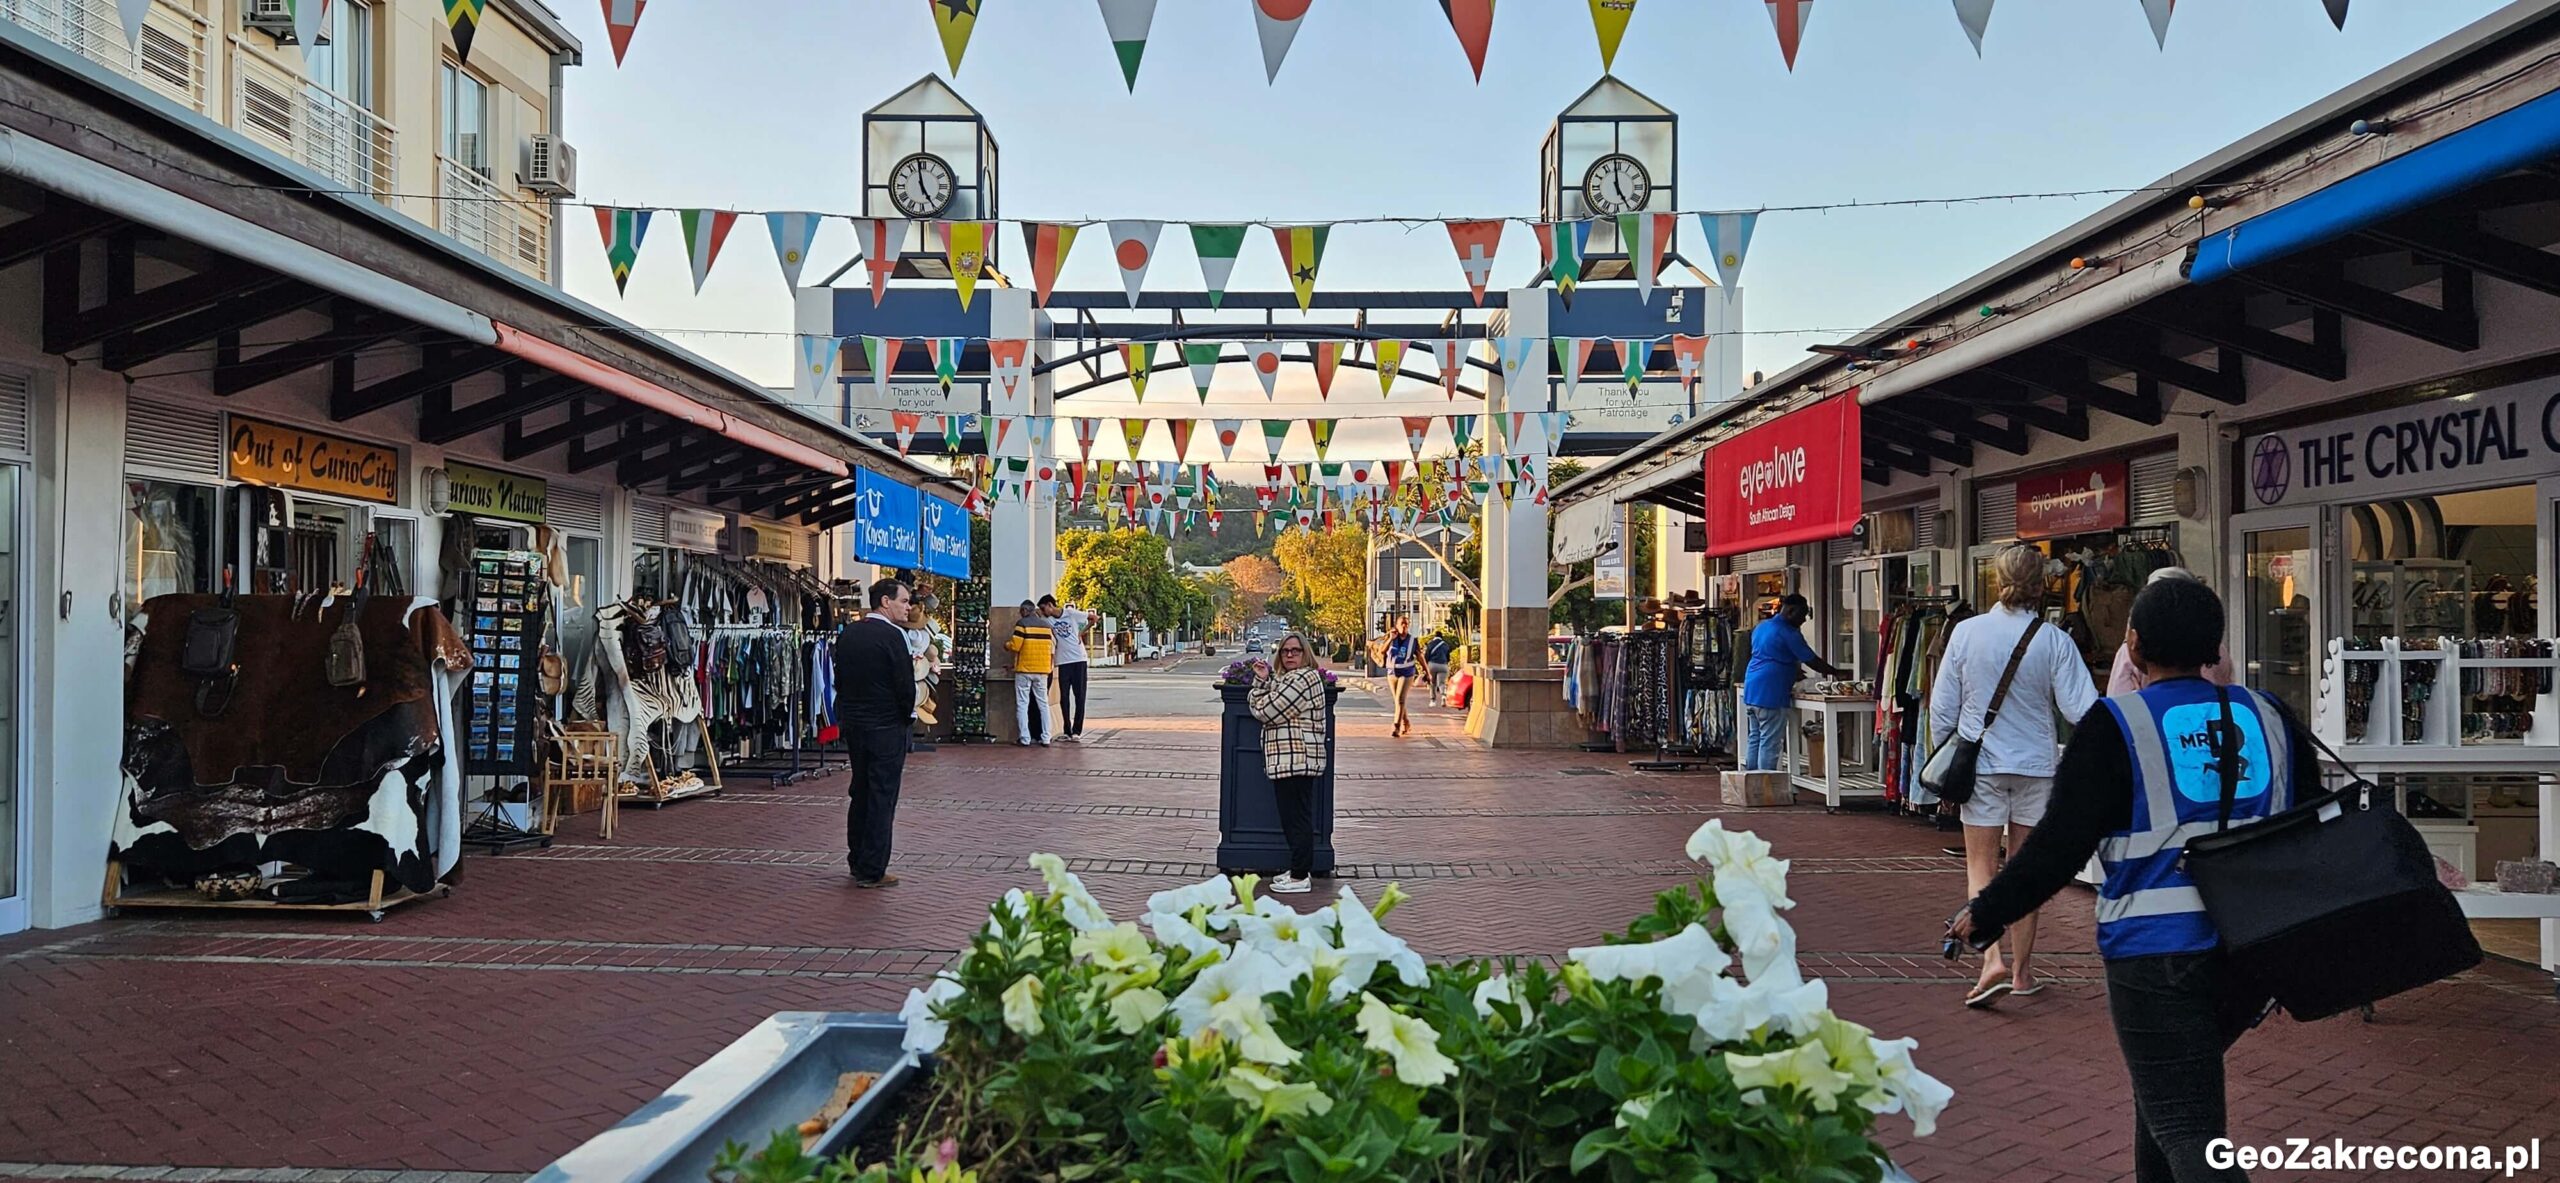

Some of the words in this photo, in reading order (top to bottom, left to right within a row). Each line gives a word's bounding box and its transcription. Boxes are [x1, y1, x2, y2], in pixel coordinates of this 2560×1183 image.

[891, 387, 920, 396] Thank
[923, 387, 942, 396] You
[1598, 387, 1628, 396] Thank
[898, 398, 911, 406] for
[914, 400, 935, 408] your
[1605, 398, 1619, 406] for
[1621, 399, 1642, 408] your
[1599, 408, 1648, 418] Patronage
[2299, 432, 2354, 488] THE
[2365, 402, 2529, 478] CRYSTAL
[233, 424, 274, 468] Out
[282, 437, 303, 483] of
[310, 442, 396, 498] CurioCity
[445, 468, 493, 509] urious
[498, 478, 545, 516] Nature
[865, 519, 888, 552] Knysna
[929, 528, 945, 557] Knysna
[2179, 732, 2209, 749] MR
